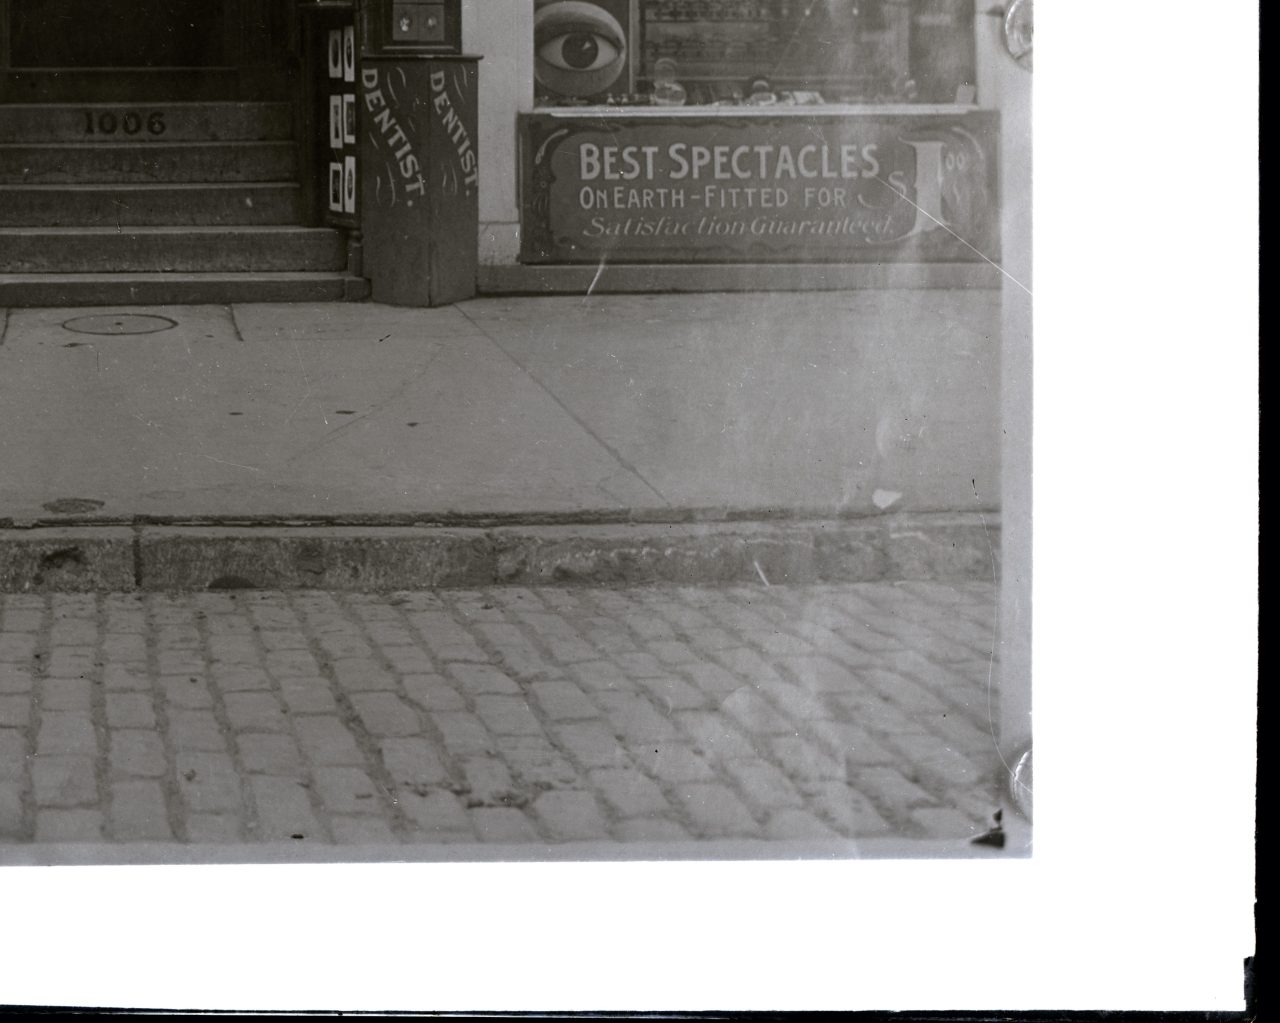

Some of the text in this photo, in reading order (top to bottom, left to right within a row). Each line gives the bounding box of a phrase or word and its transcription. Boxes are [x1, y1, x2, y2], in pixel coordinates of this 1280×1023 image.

[84, 110, 167, 136] 1006
[360, 67, 426, 208] DENTIST.
[579, 141, 881, 180] BEST SPECTACLES
[802, 187, 849, 209] FOR
